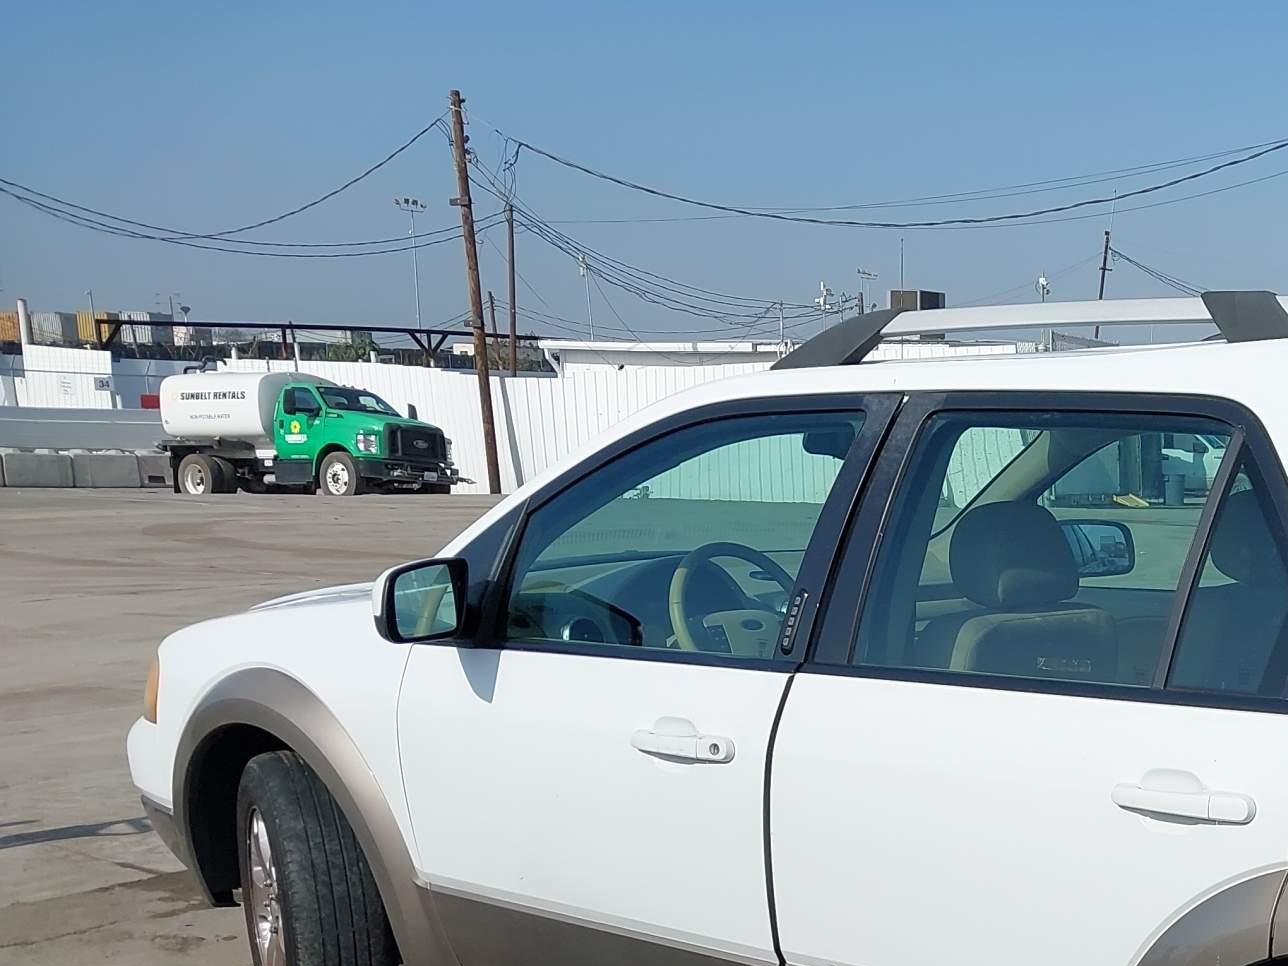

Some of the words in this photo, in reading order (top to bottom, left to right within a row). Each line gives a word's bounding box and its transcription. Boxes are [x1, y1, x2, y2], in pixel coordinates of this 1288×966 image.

[98, 380, 110, 388] 34
[180, 391, 212, 401] SUNBELT
[212, 391, 246, 400] RENTALS
